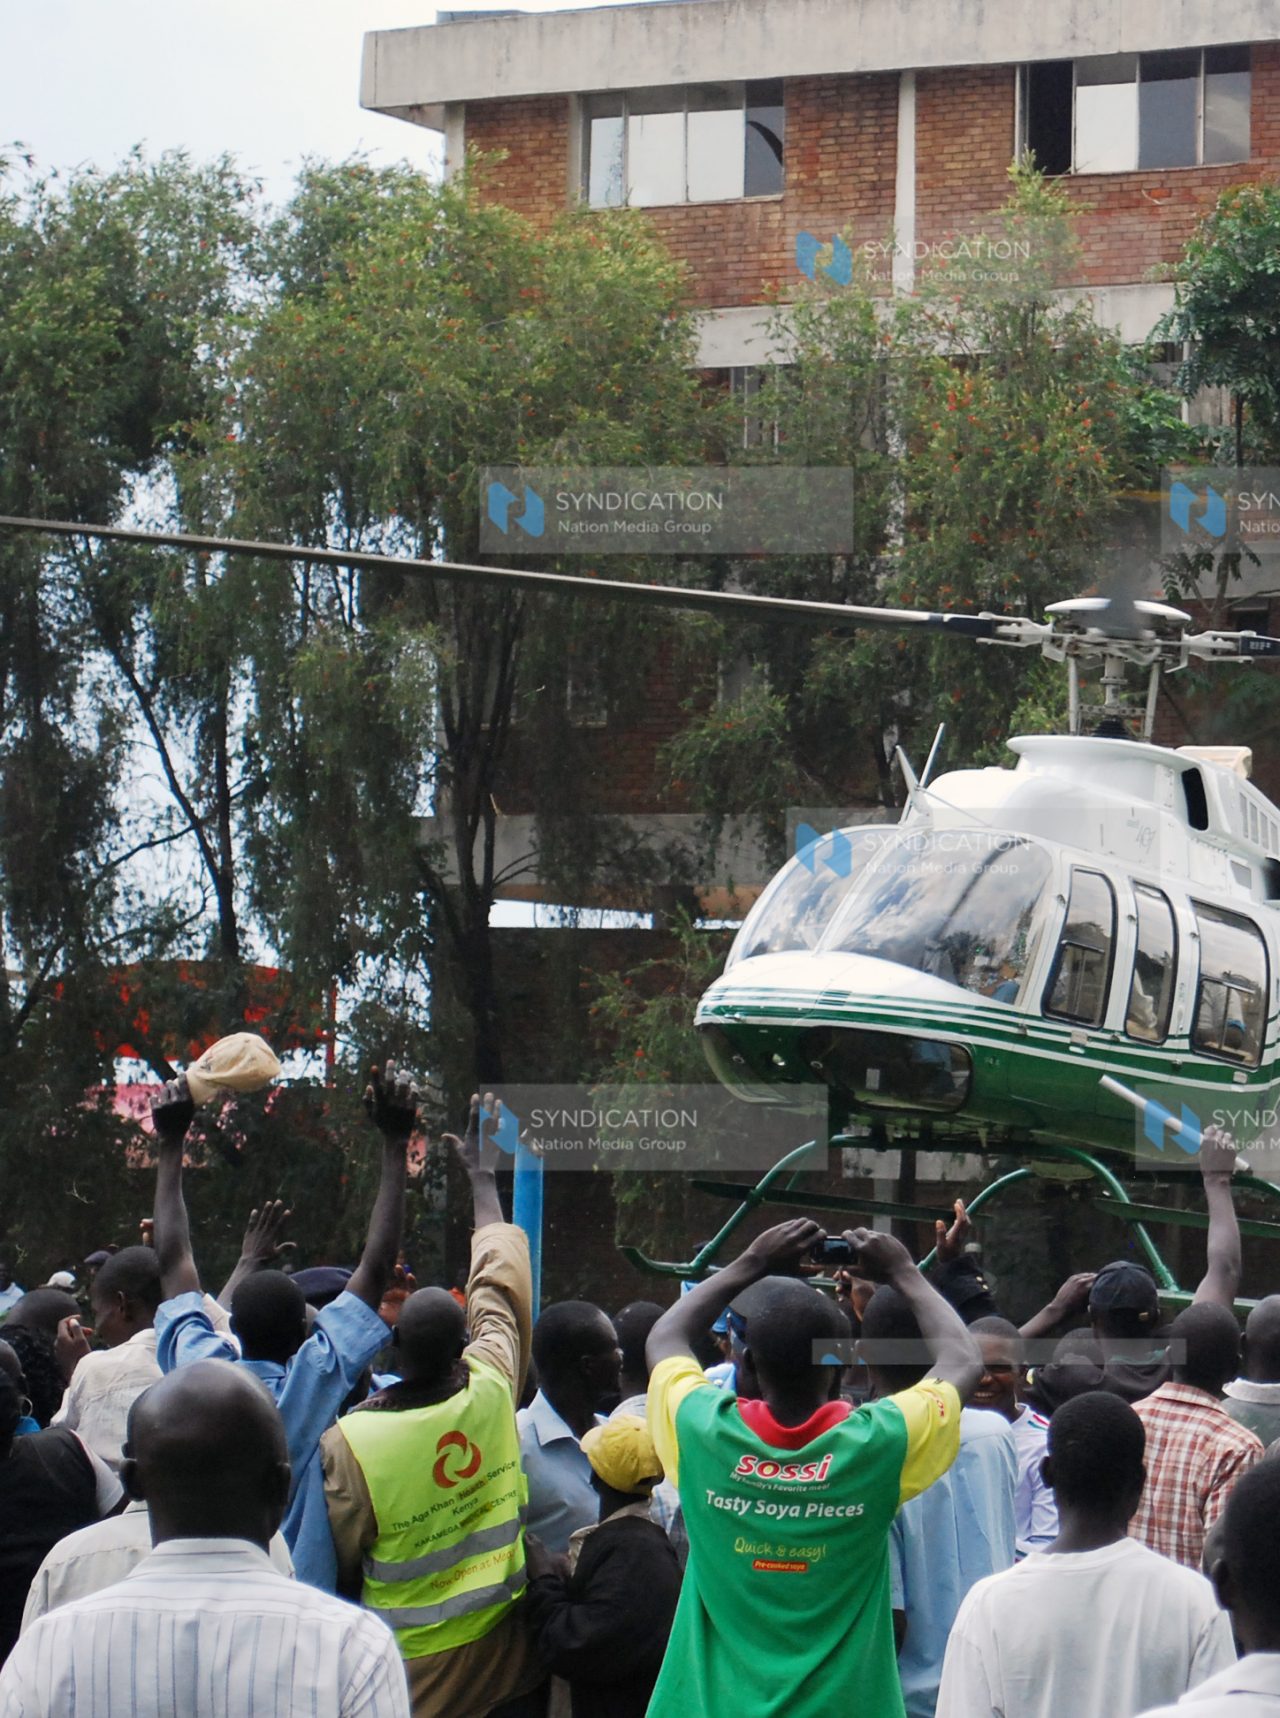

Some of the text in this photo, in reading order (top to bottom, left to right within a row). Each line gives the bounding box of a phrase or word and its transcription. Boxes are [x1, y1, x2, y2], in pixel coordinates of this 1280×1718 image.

[392, 1519, 411, 1532] The
[412, 1511, 430, 1524] Aga
[430, 1497, 455, 1514] Khan
[458, 1479, 486, 1500] Health
[415, 1526, 460, 1548] KAKAMEGA
[491, 1489, 517, 1509] CENTRE
[452, 1498, 479, 1516] Kenya
[705, 1489, 865, 1520] Tasty Soya Pieces
[734, 1536, 773, 1556] Quick
[789, 1543, 827, 1563] easy!
[430, 1575, 453, 1590] Now
[454, 1564, 478, 1582] Open
[479, 1559, 490, 1570] at
